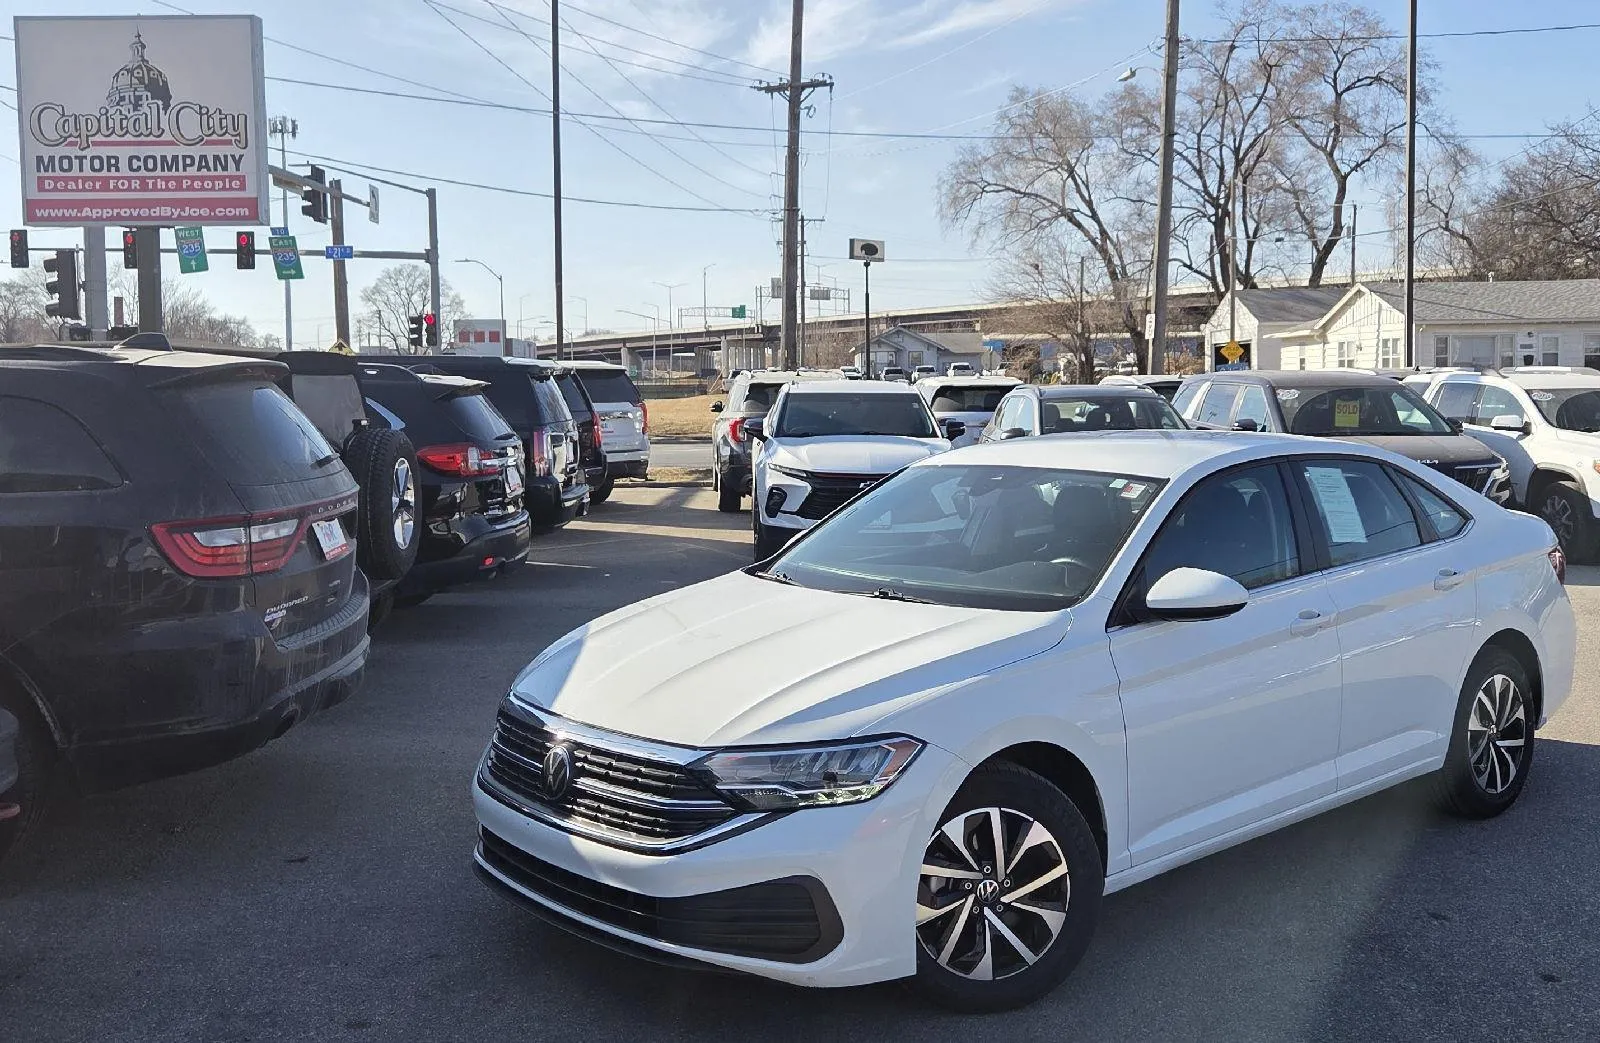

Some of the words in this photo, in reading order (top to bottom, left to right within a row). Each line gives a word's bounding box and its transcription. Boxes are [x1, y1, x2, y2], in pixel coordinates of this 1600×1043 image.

[30, 101, 165, 151] Capital
[168, 101, 249, 149] City
[35, 155, 120, 173] MOTOR
[127, 154, 244, 173] COMPANY
[44, 179, 102, 190] Dealer
[109, 179, 141, 190] FOR
[146, 179, 177, 190] The
[182, 178, 241, 191] People
[35, 206, 250, 219] www.ApprovedByJoe.com
[177, 229, 200, 238] WEST
[272, 238, 293, 247] EAST
[182, 243, 201, 254] 235
[277, 252, 296, 261] 235
[1336, 404, 1358, 415] SOLD
